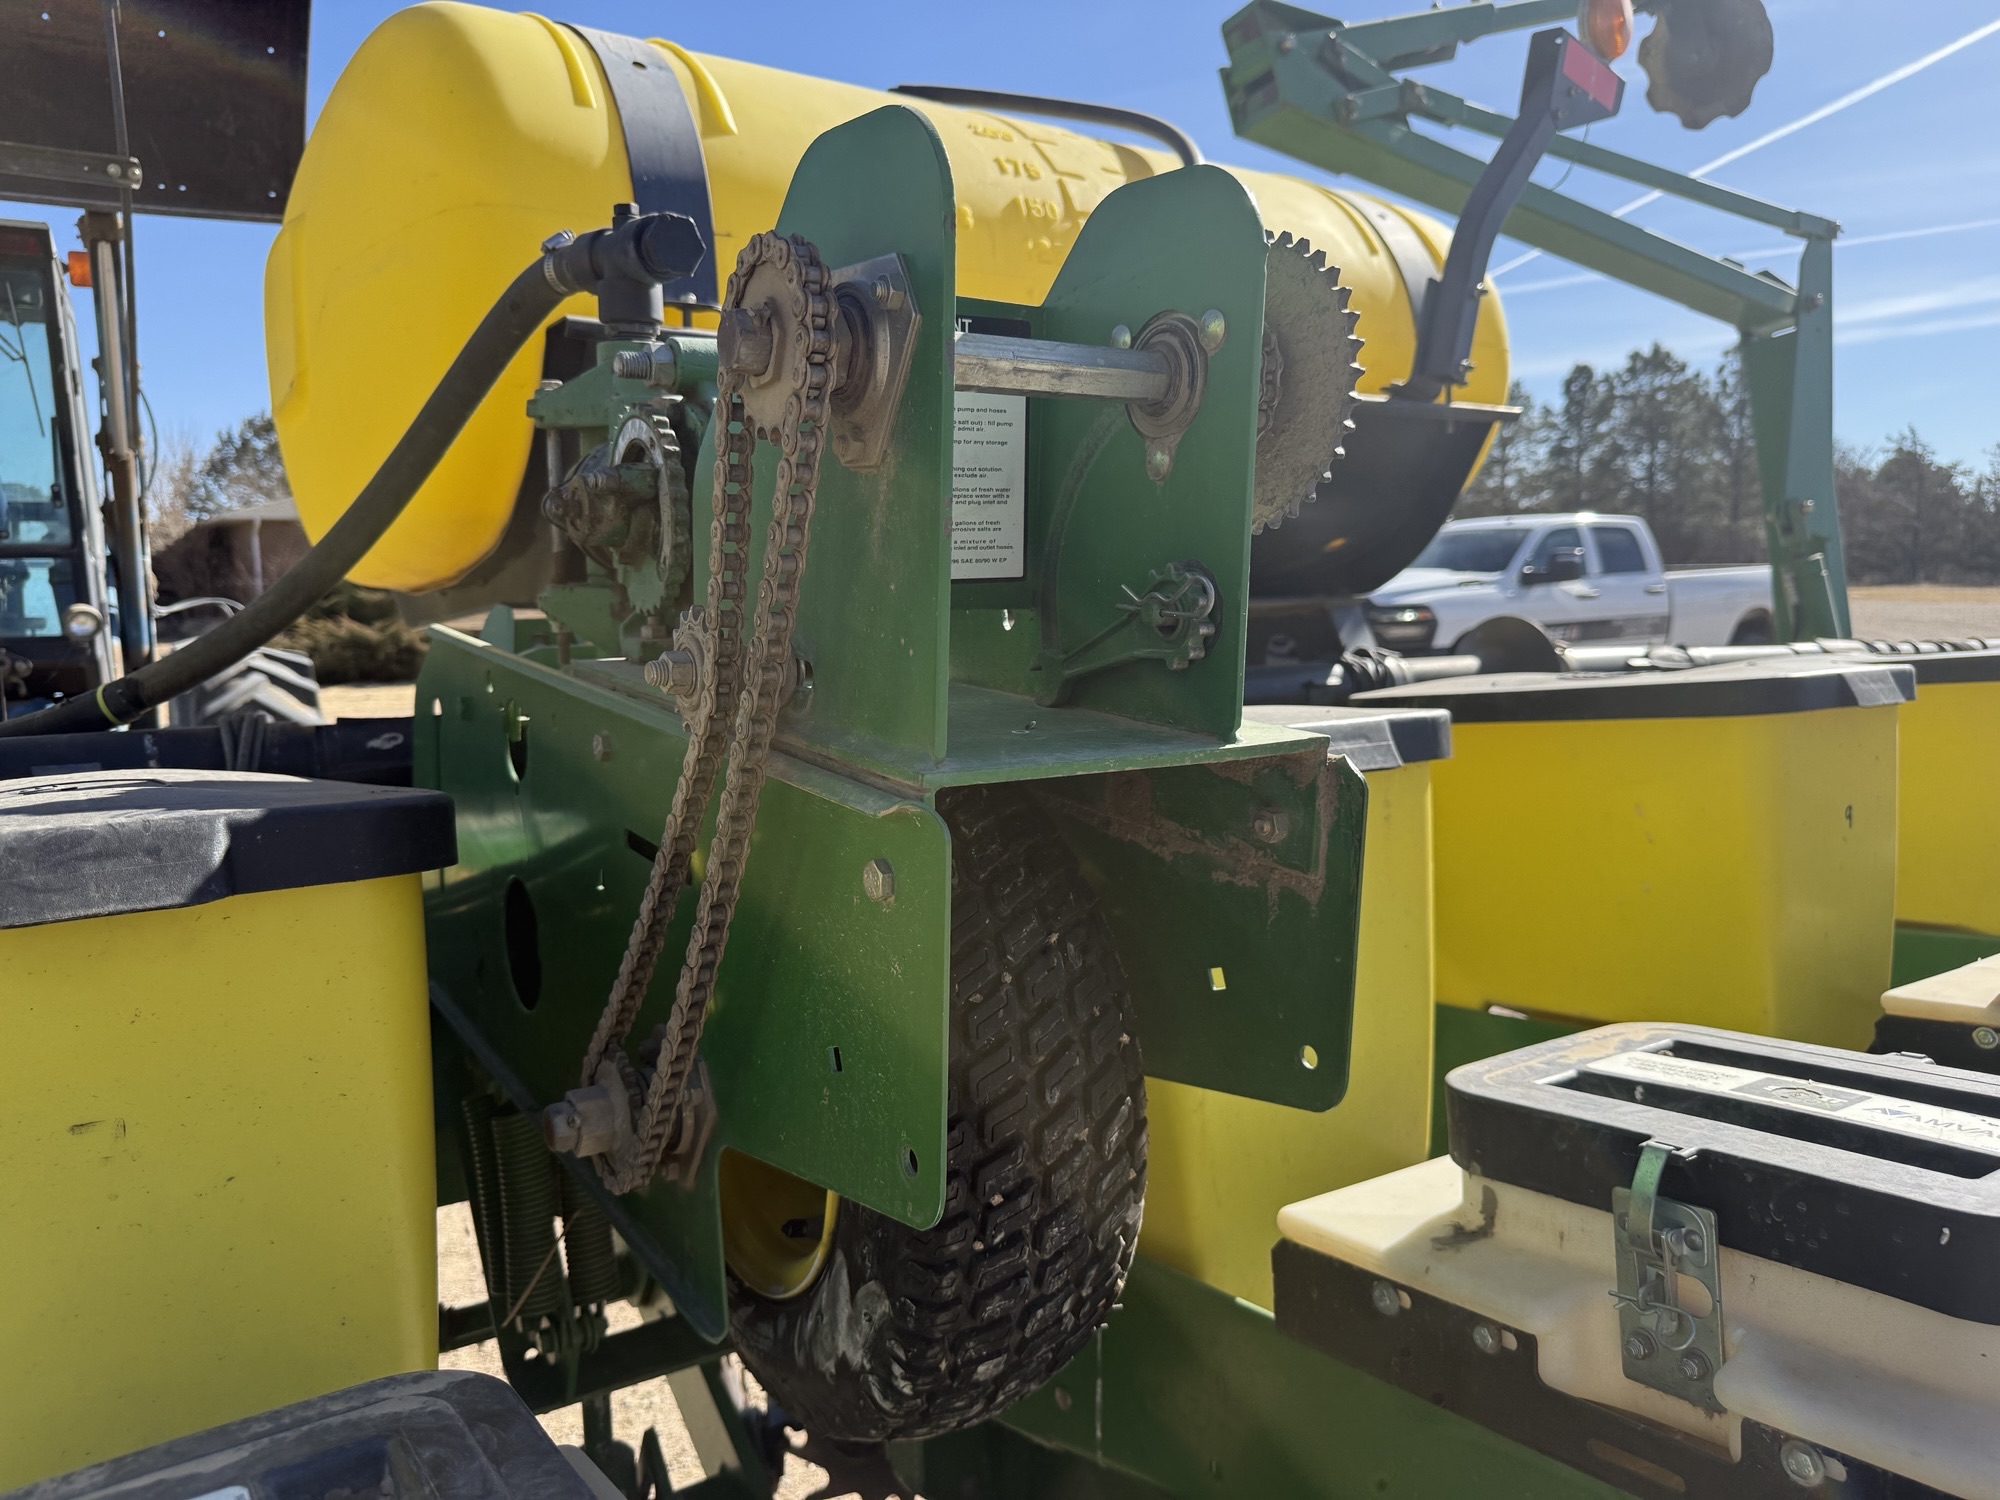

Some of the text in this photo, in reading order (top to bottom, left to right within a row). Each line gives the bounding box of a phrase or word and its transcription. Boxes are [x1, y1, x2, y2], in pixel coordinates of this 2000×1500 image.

[994, 155, 1042, 181] 175
[1013, 193, 1062, 223] 150
[1896, 1114, 2000, 1141] AMVA
